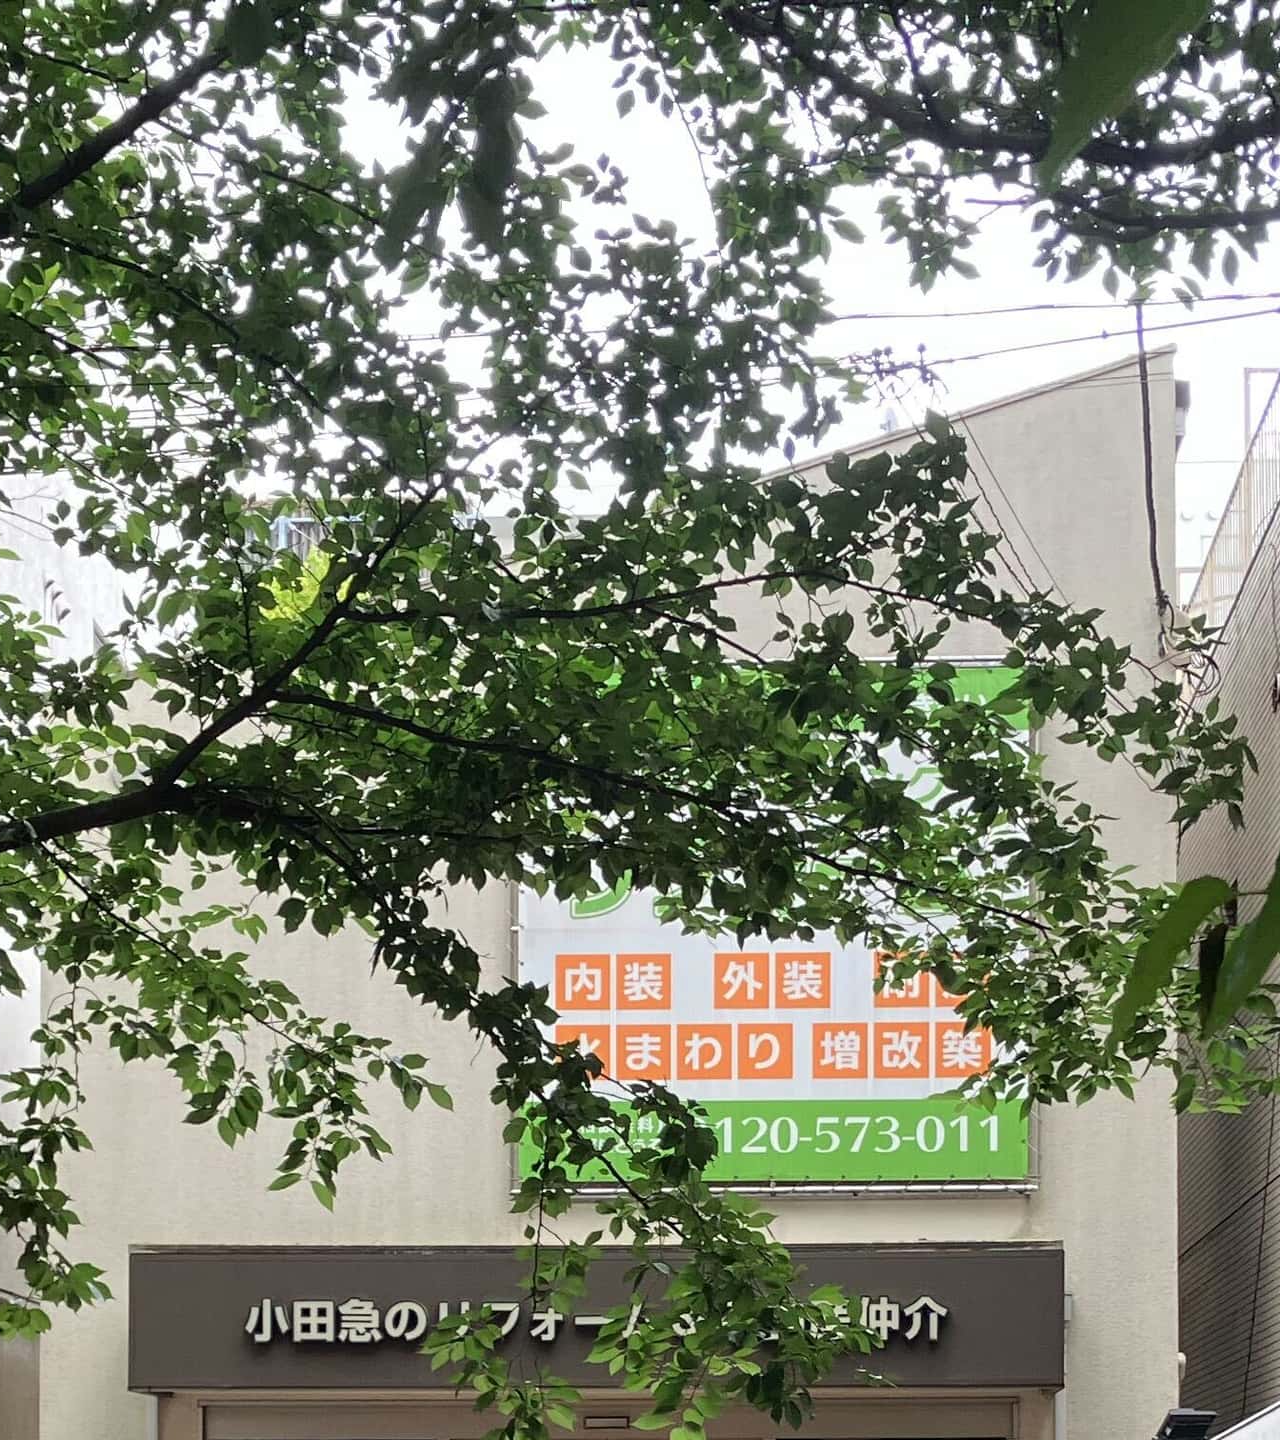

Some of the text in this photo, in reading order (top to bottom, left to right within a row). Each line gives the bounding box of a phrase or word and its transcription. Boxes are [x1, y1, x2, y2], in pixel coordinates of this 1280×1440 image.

[564, 960, 823, 1001] 内装 外装
[820, 1030, 983, 1070] 増改築
